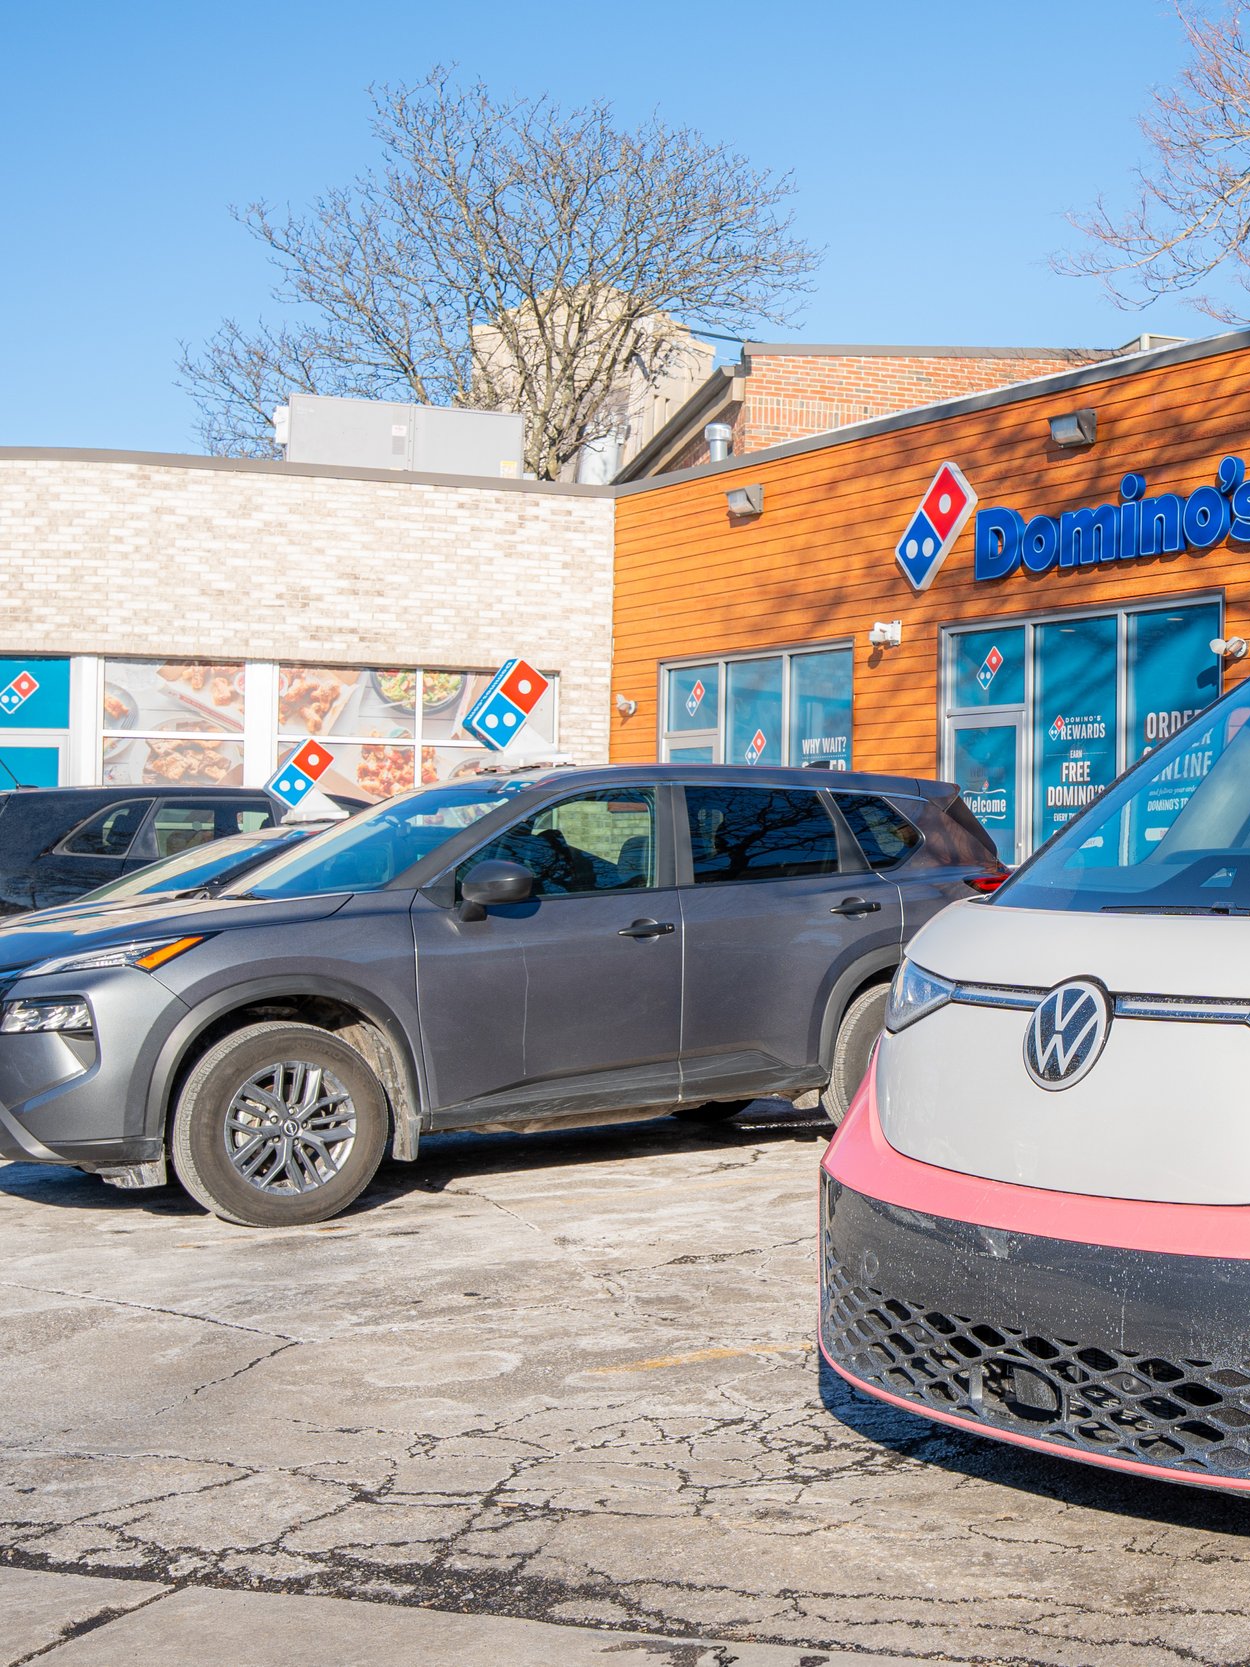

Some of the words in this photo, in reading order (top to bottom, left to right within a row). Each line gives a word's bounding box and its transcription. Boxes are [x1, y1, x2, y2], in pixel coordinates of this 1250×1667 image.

[1065, 715, 1102, 723] DOMINO'S
[1145, 709, 1203, 739] ORDE
[1061, 723, 1105, 741] REWARDS
[802, 738, 820, 754] WHY
[822, 736, 847, 753] WAIT?
[1070, 750, 1082, 758] EARN
[1062, 761, 1091, 782] FREE
[1151, 751, 1213, 782] NLINE
[963, 796, 1006, 813] Welcome
[1147, 798, 1179, 811] DOMINO'S
[1053, 813, 1067, 821] EVERY
